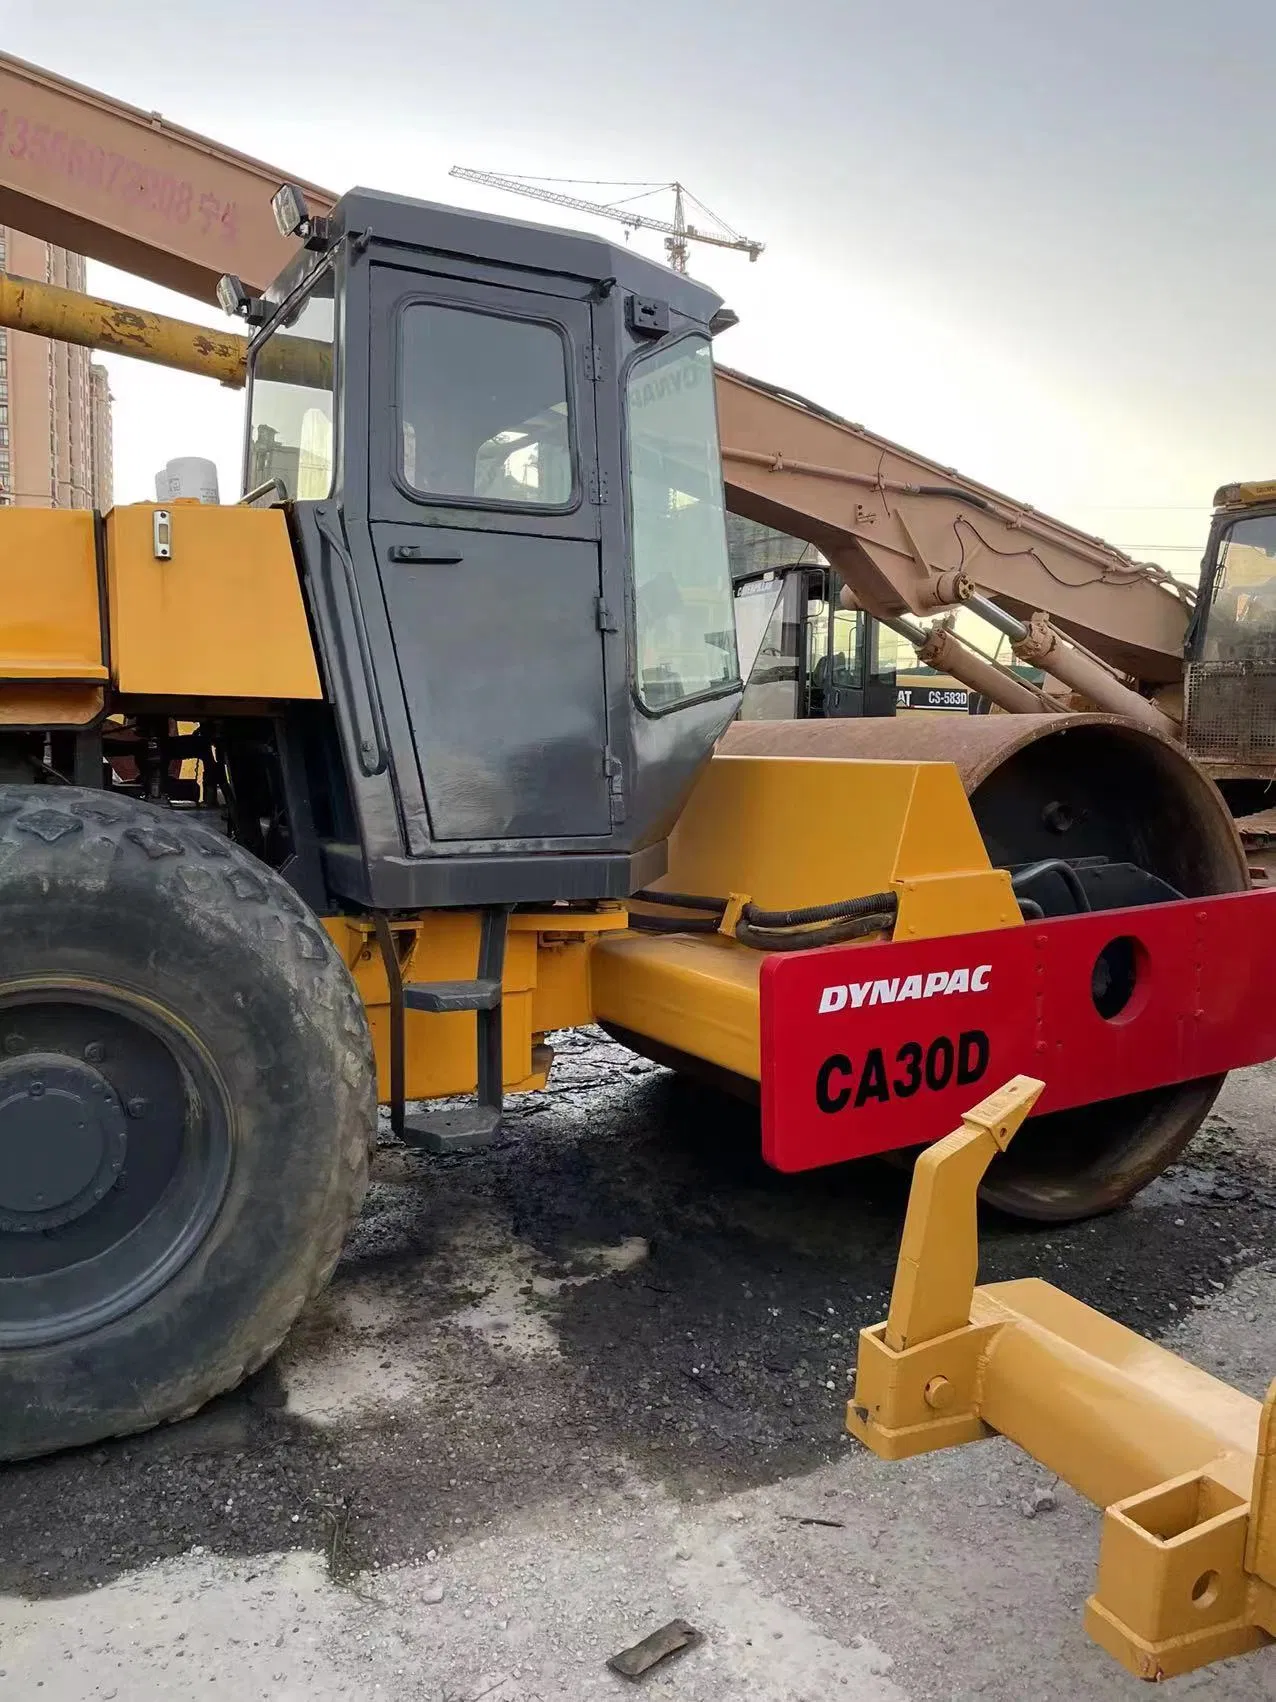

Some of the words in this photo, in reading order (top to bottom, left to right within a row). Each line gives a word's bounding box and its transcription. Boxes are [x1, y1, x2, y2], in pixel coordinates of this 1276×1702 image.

[928, 691, 967, 705] CS-583D
[818, 964, 993, 1014] DYNAPAC
[815, 1029, 990, 1114] CA30D
